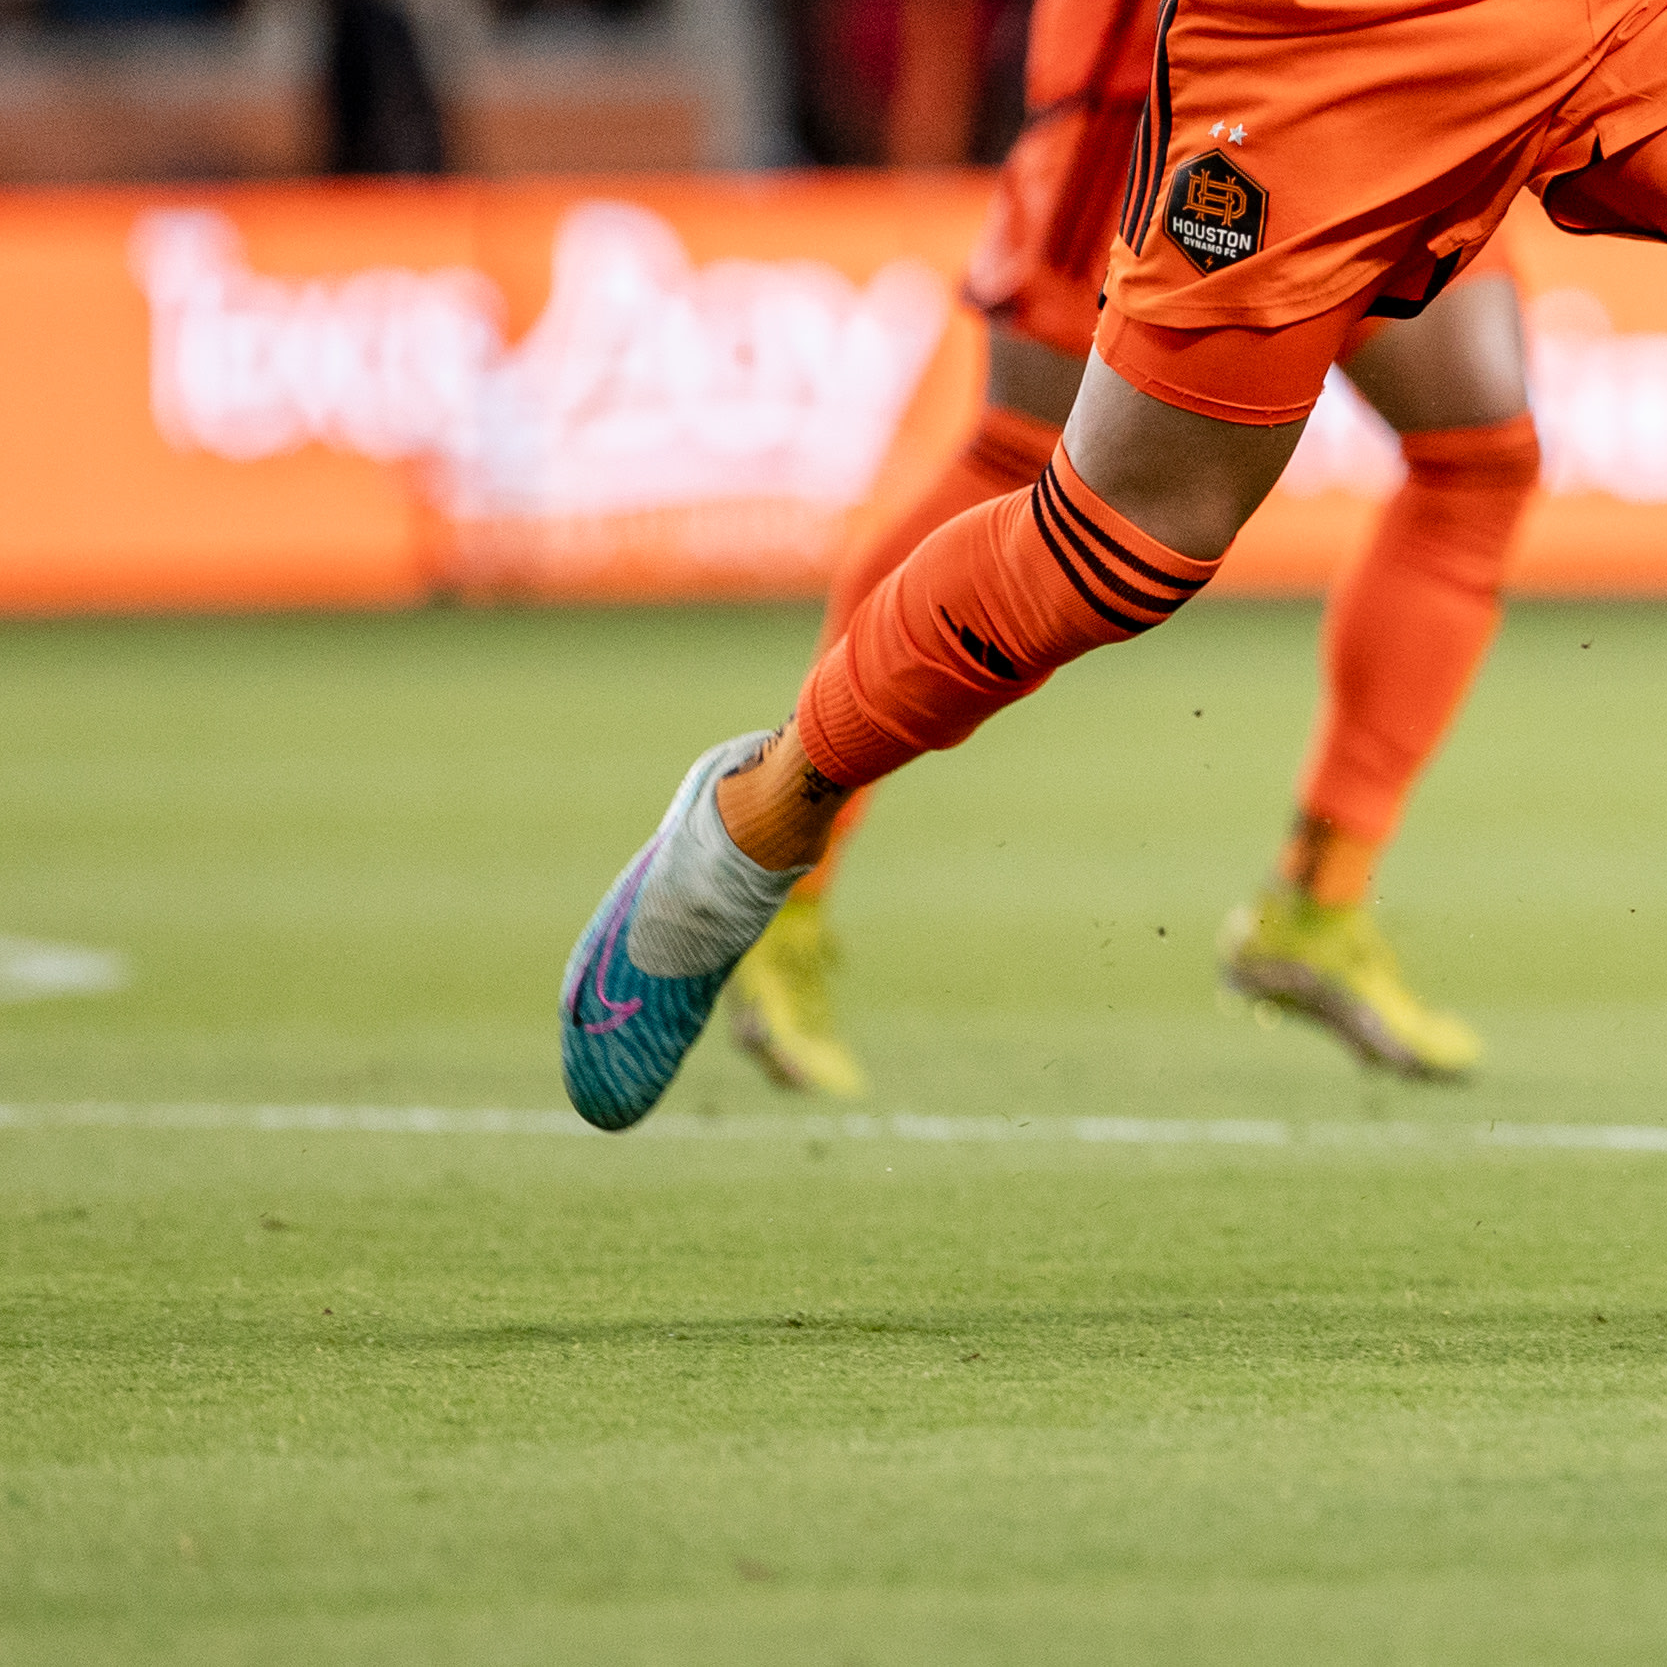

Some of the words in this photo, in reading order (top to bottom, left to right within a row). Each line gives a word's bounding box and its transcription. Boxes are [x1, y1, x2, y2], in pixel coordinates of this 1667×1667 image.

[1172, 216, 1252, 251] HOUSTON
[1183, 235, 1223, 256] DYNAMO
[1223, 245, 1237, 259] FC
